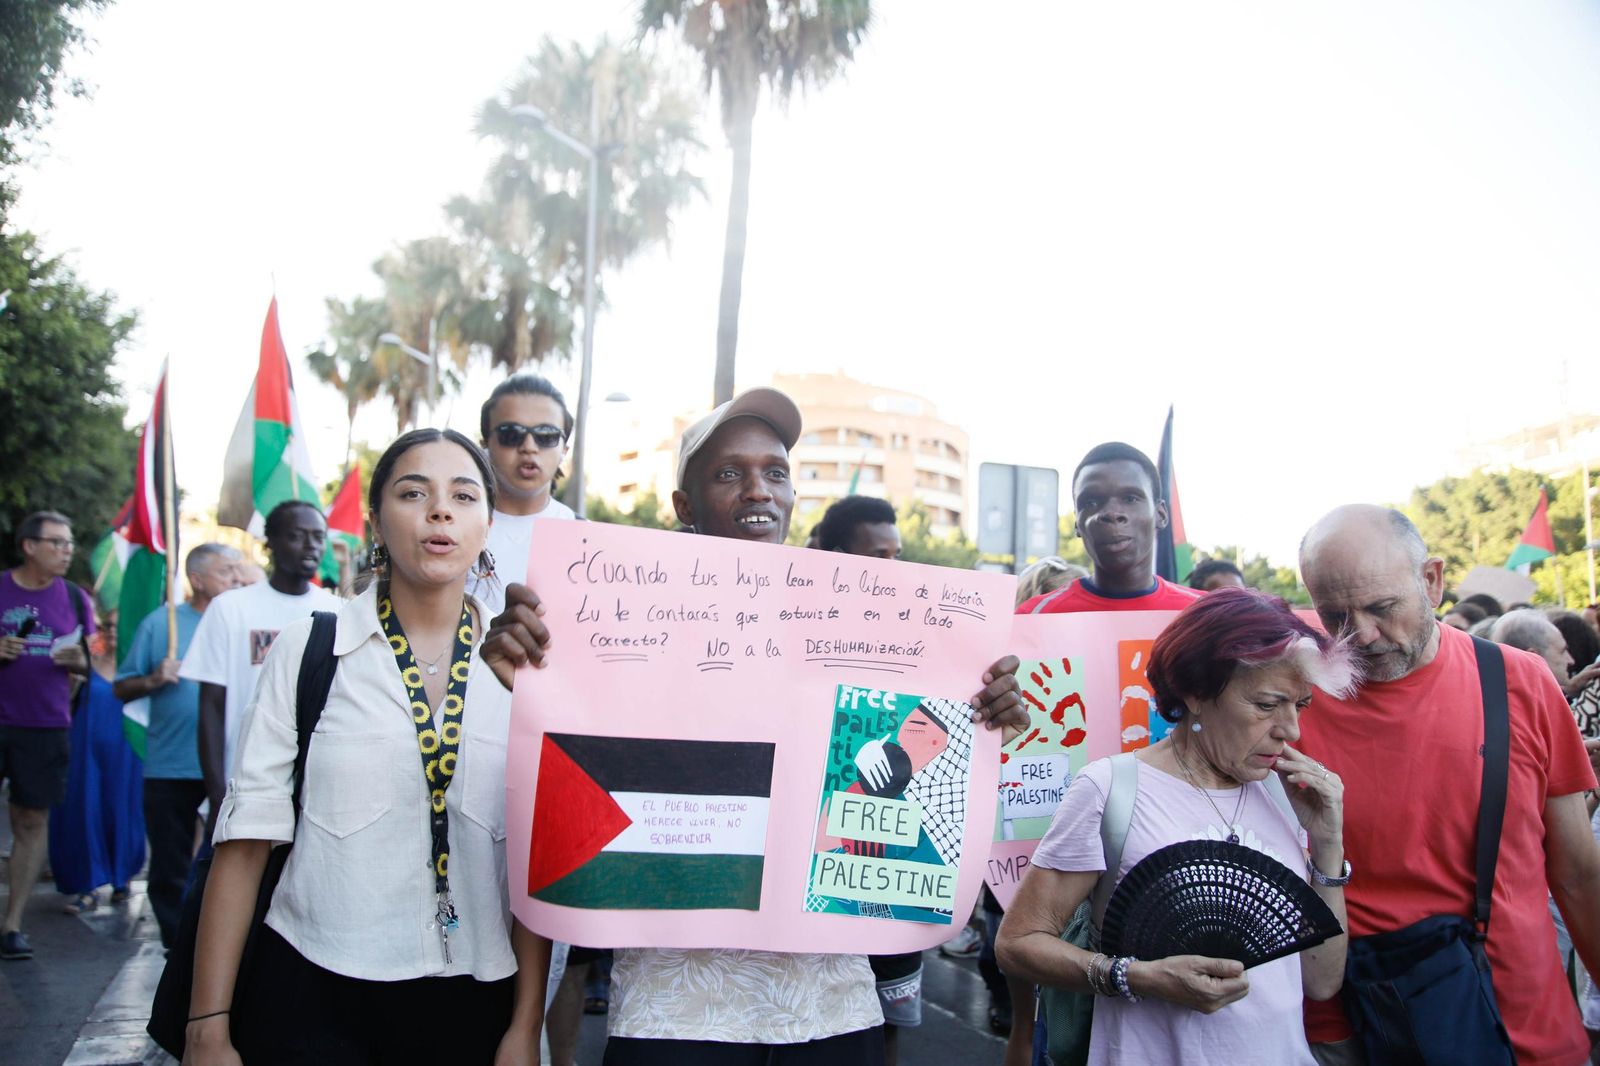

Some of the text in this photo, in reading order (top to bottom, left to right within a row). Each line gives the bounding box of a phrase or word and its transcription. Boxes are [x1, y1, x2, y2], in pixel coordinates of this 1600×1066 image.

[691, 557, 718, 586] tus
[736, 557, 770, 598] hijos
[786, 562, 814, 588] lean
[859, 570, 896, 597] libros
[915, 584, 929, 600] de
[941, 583, 984, 607] historia
[576, 594, 600, 624] tu
[615, 598, 630, 622] te
[735, 610, 759, 631] que
[779, 606, 839, 621] estuviste
[864, 609, 880, 620] en
[898, 609, 910, 621] el
[923, 608, 953, 629] lado
[707, 637, 730, 658] NO
[745, 645, 756, 657] a
[765, 638, 782, 657] la
[1021, 763, 1053, 780] FREE
[642, 800, 748, 812] EL PUEBLO PALESTINO
[1007, 786, 1064, 806] PALESTINE
[727, 818, 742, 828] NO
[841, 800, 910, 836] FREE
[819, 857, 952, 899] PALESTINE
[987, 855, 1031, 886] IMP
